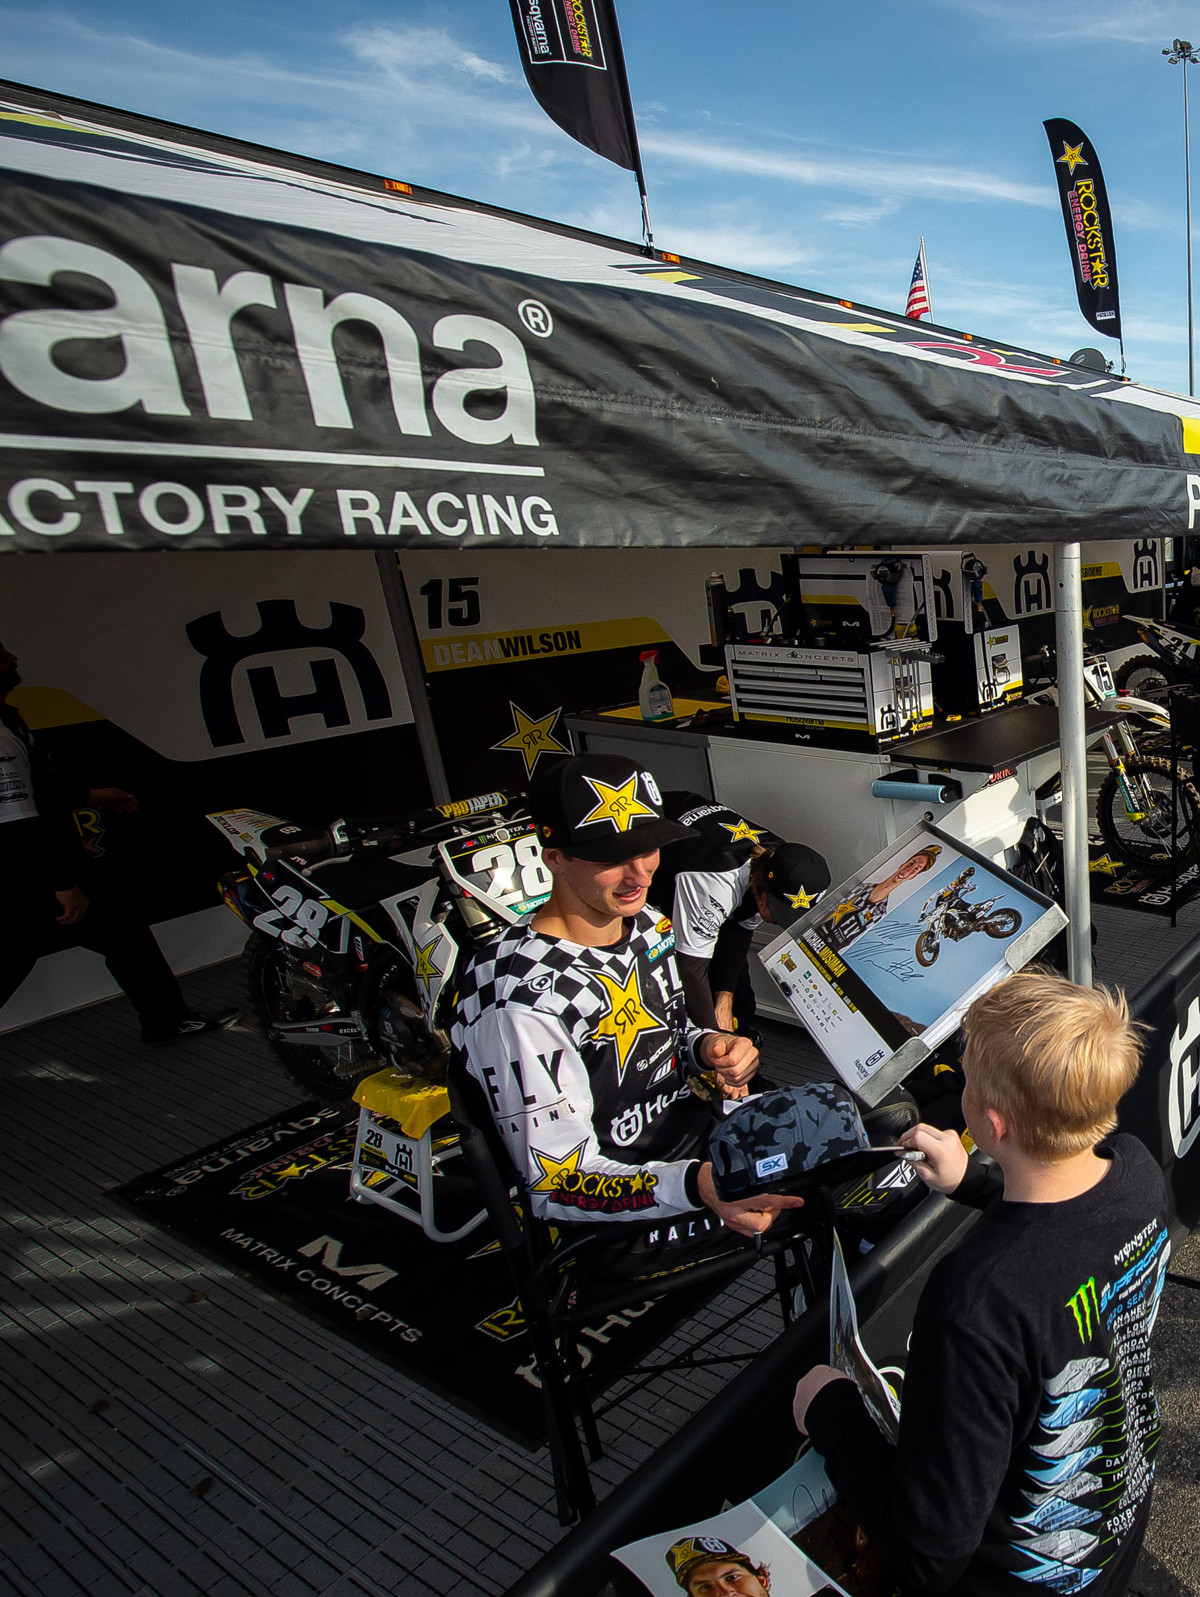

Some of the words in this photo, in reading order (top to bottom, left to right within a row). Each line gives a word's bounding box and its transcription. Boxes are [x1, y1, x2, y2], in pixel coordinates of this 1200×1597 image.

[1069, 190, 1086, 239] ENERGY
[1079, 244, 1092, 281] DRINK
[336, 487, 561, 537] RACING
[419, 576, 482, 630] 15
[738, 649, 781, 659] MATRIX
[471, 835, 554, 907] 28
[482, 1048, 565, 1113] FLY
[365, 1129, 383, 1149] 28
[762, 1158, 781, 1173] SX
[648, 1218, 724, 1245] RACI
[1113, 1217, 1158, 1266] MONSTER
[219, 1226, 299, 1273] MATRIX
[295, 1268, 423, 1344] CONCEPTS
